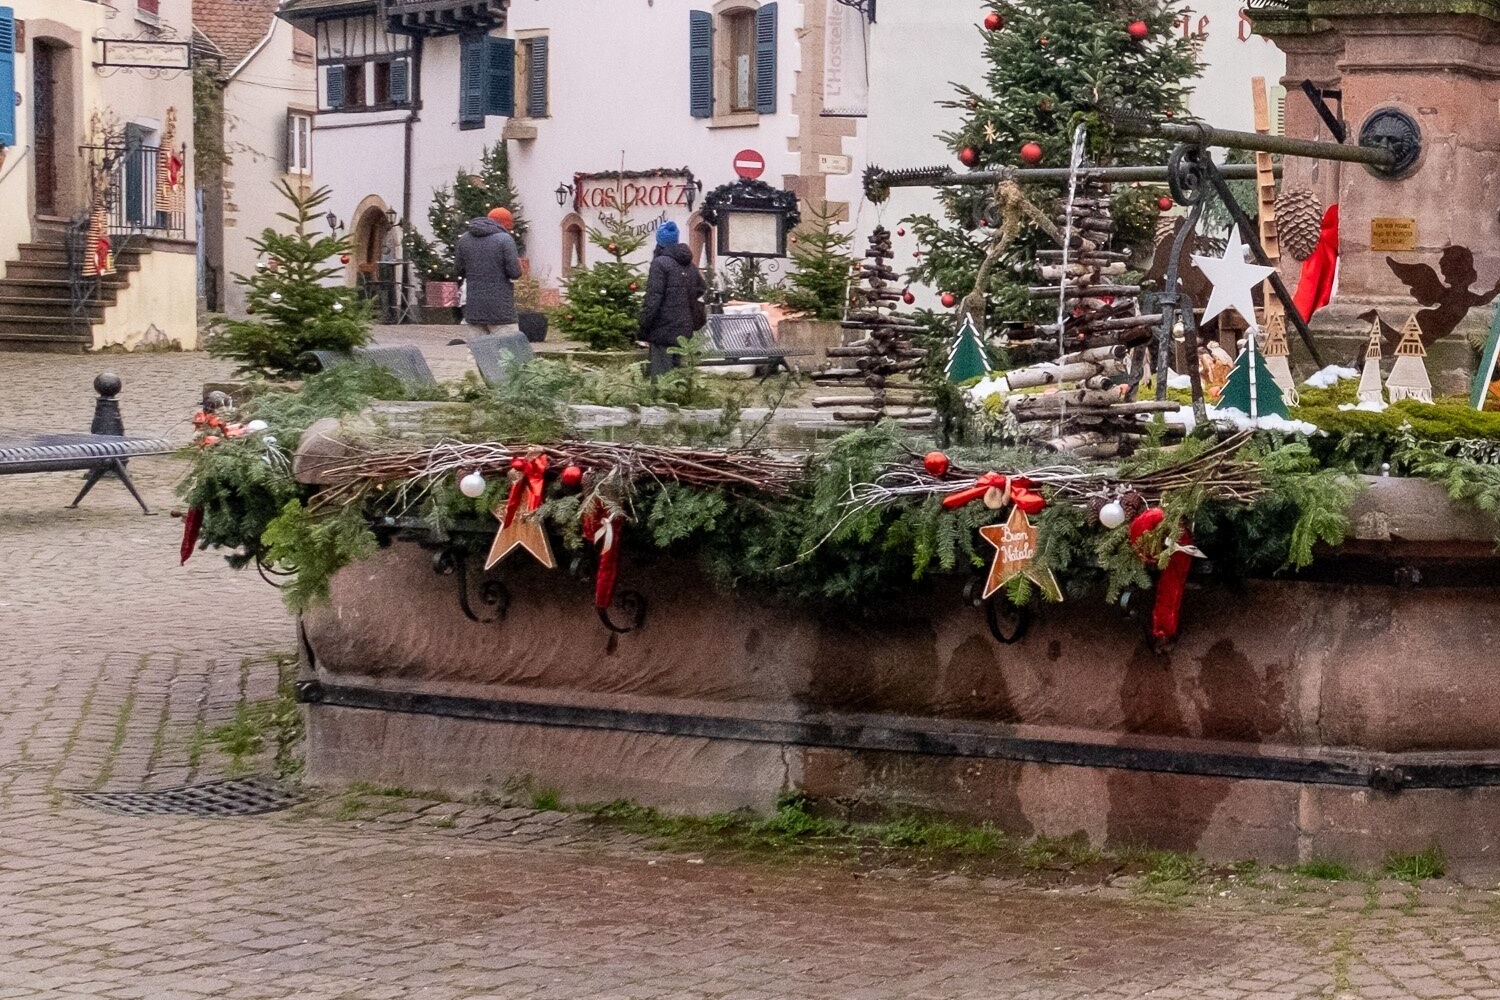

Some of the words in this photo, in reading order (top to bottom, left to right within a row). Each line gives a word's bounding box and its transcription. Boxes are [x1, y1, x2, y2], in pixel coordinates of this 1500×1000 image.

[826, 0, 843, 97] L'Hostelle
[1001, 526, 1029, 542] Buon
[1001, 542, 1034, 563] Natale
